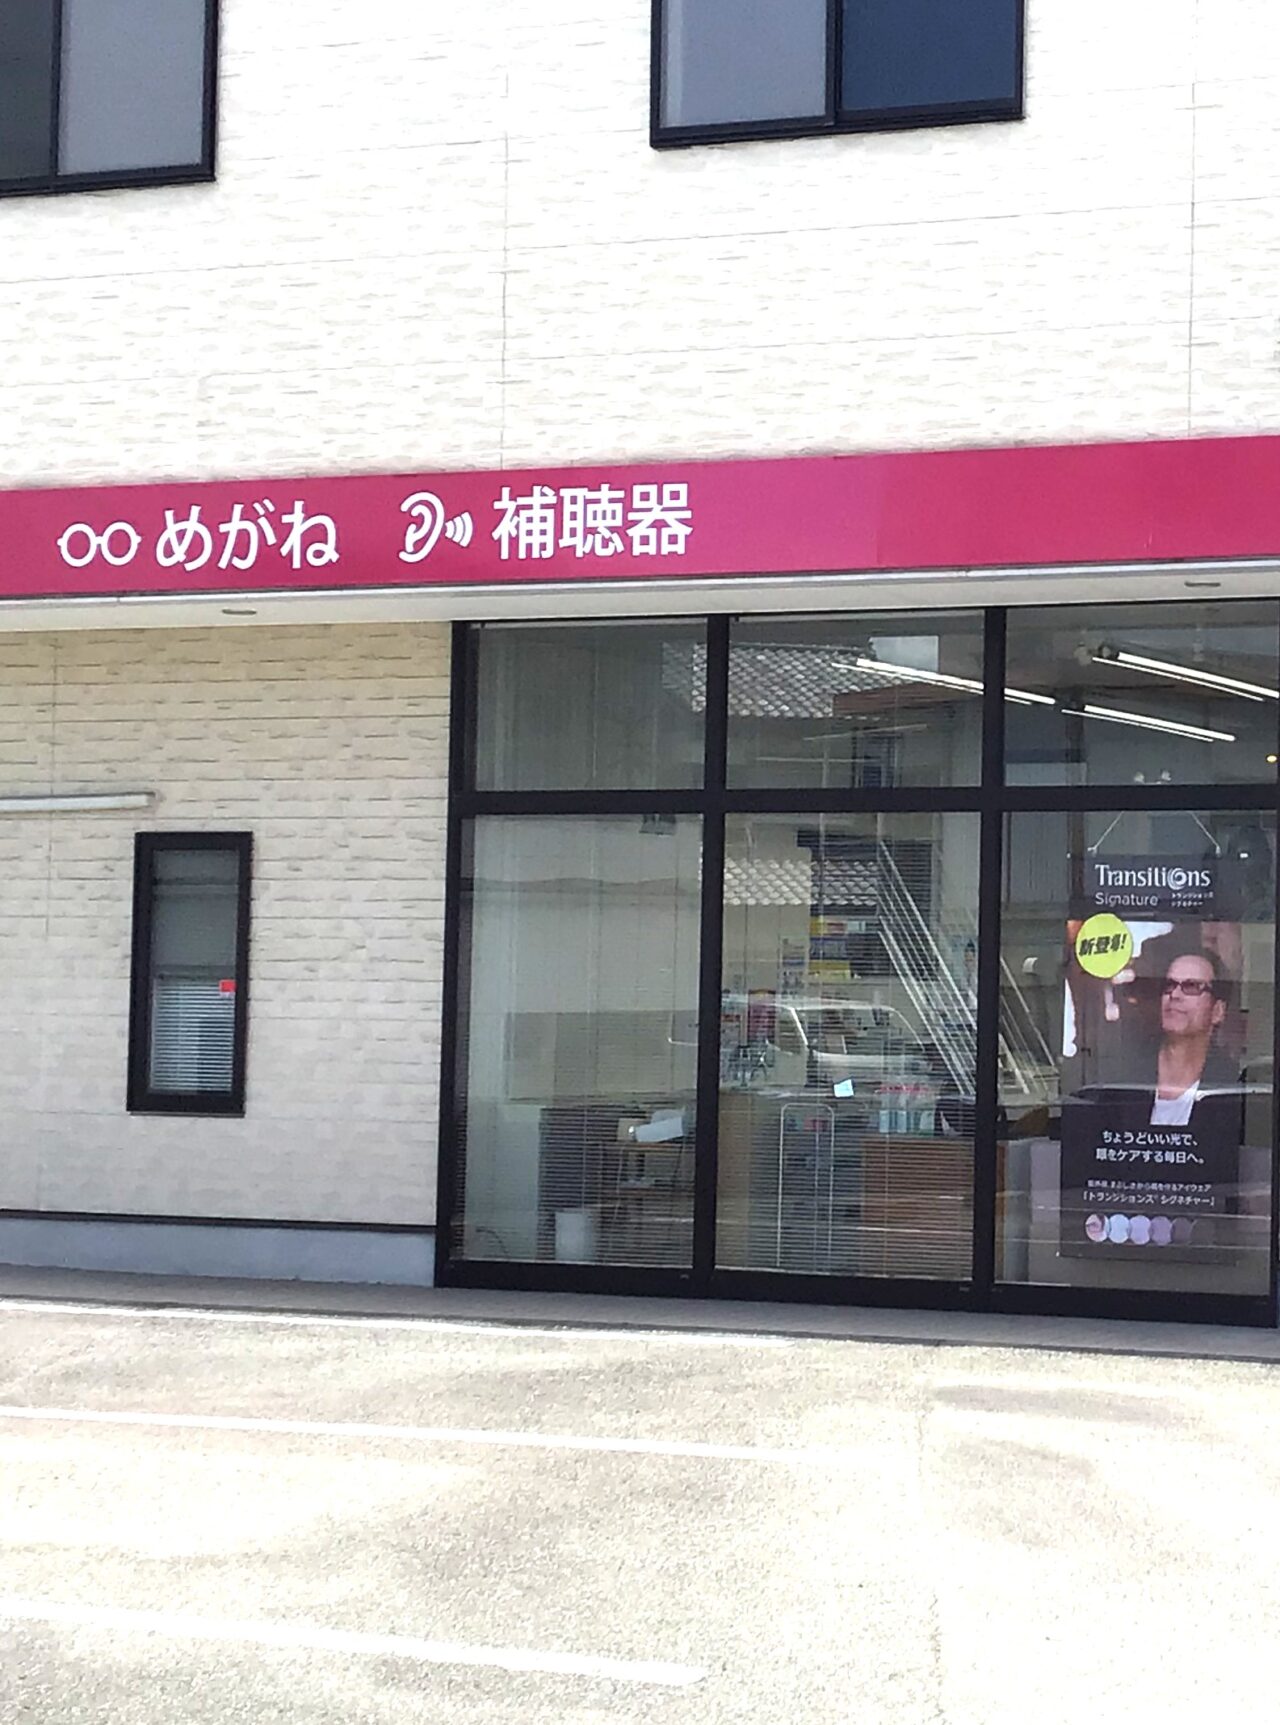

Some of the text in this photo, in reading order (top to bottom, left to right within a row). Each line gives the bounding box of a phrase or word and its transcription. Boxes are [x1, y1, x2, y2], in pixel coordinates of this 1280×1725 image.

[154, 497, 340, 571] めがね
[491, 482, 694, 560] 補聴器
[1094, 863, 1212, 891] Transitions
[1094, 891, 1160, 908] Signature
